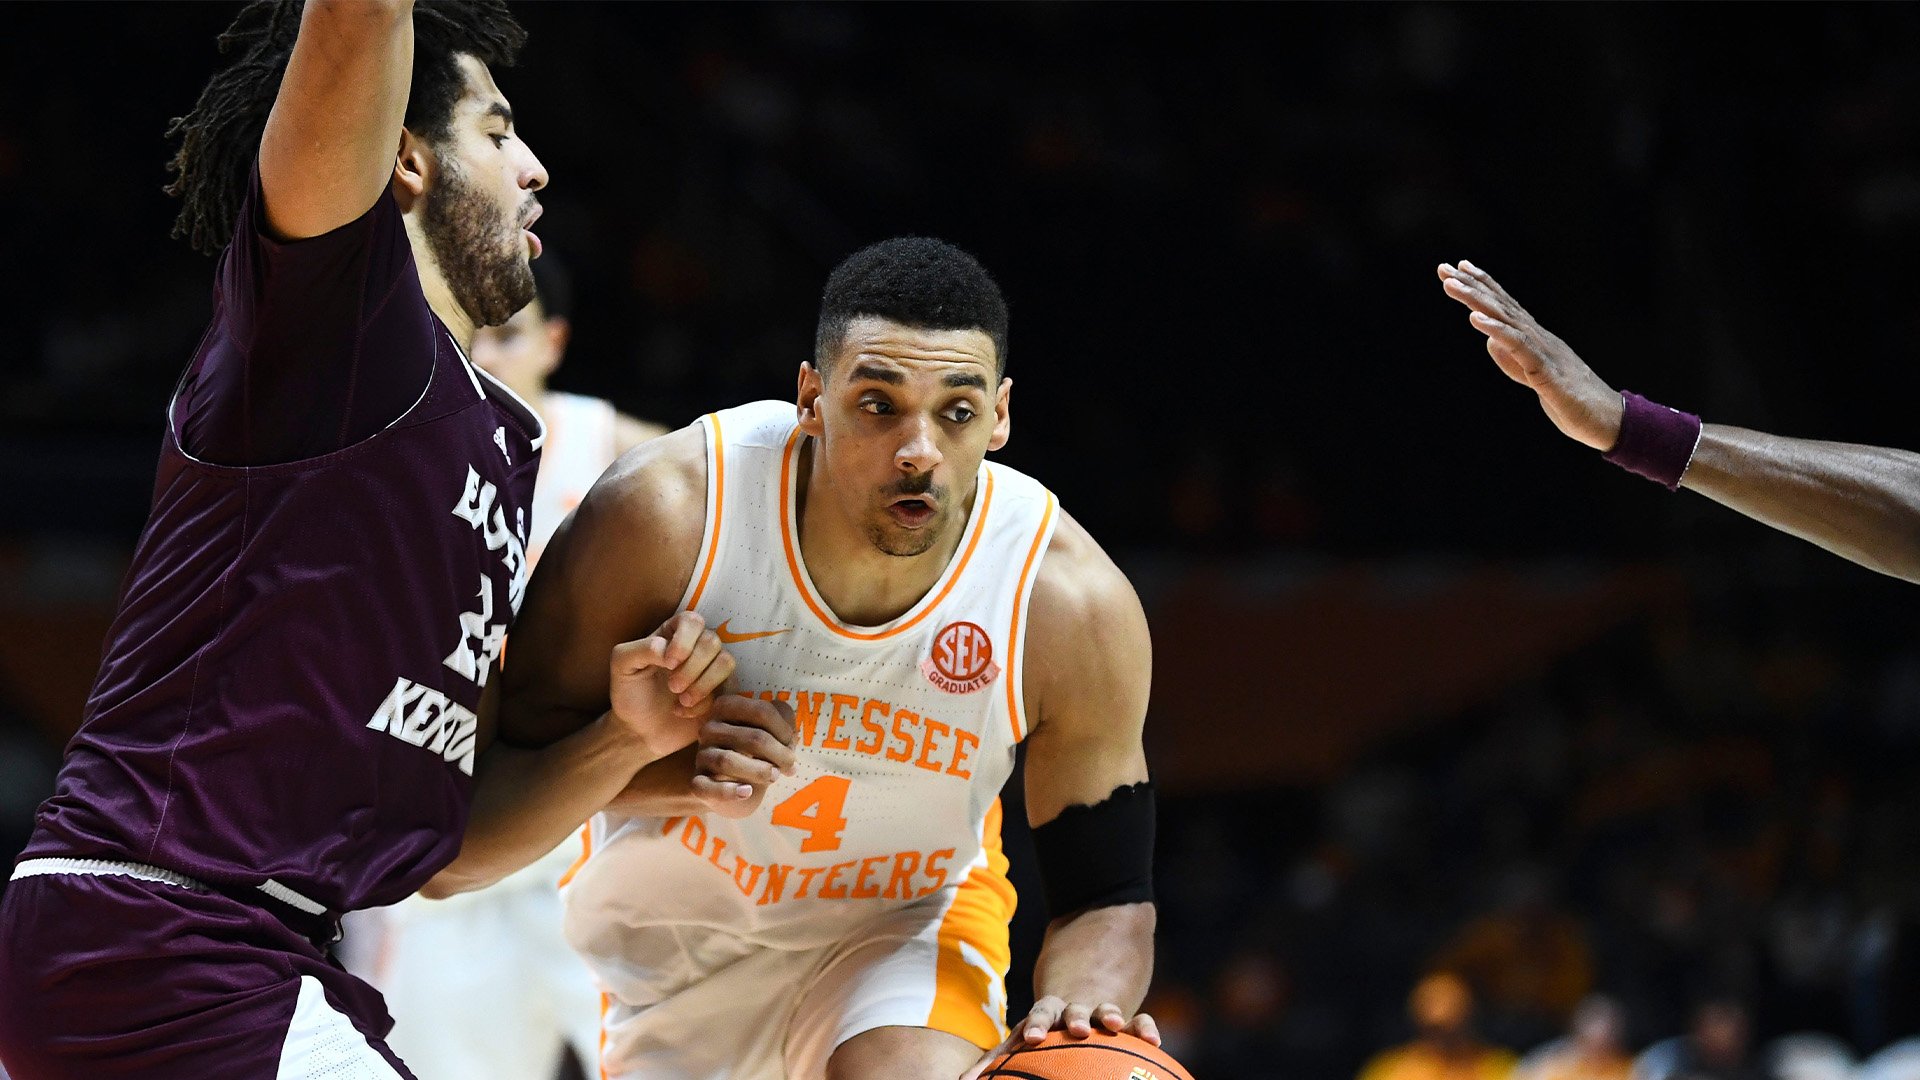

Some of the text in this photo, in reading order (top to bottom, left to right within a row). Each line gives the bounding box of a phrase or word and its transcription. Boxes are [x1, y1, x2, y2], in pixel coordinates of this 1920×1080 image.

[929, 671, 990, 694] GRADUATE
[939, 625, 987, 676] SEC
[737, 691, 980, 780] NESSEE
[770, 775, 852, 854] 4
